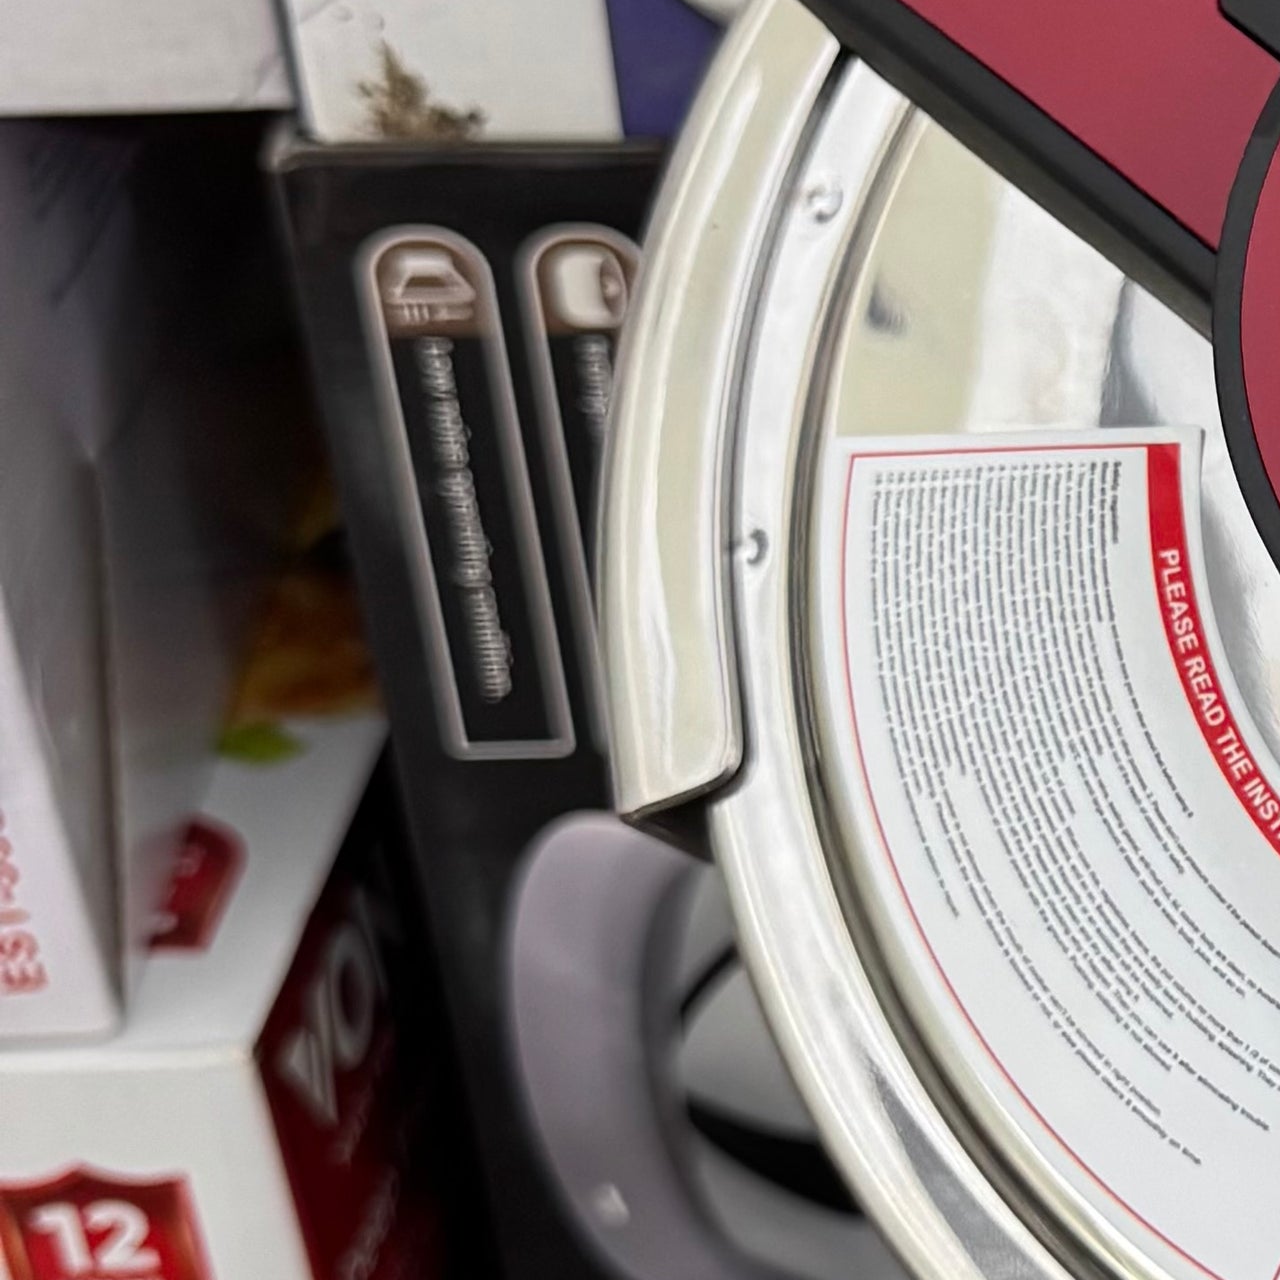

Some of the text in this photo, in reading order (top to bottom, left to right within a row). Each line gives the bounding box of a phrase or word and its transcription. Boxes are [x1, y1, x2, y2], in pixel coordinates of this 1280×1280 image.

[1158, 548, 1200, 656] PLEASE
[1185, 657, 1226, 725] READ
[1215, 724, 1252, 777] THE
[30, 1200, 162, 1275] 12
